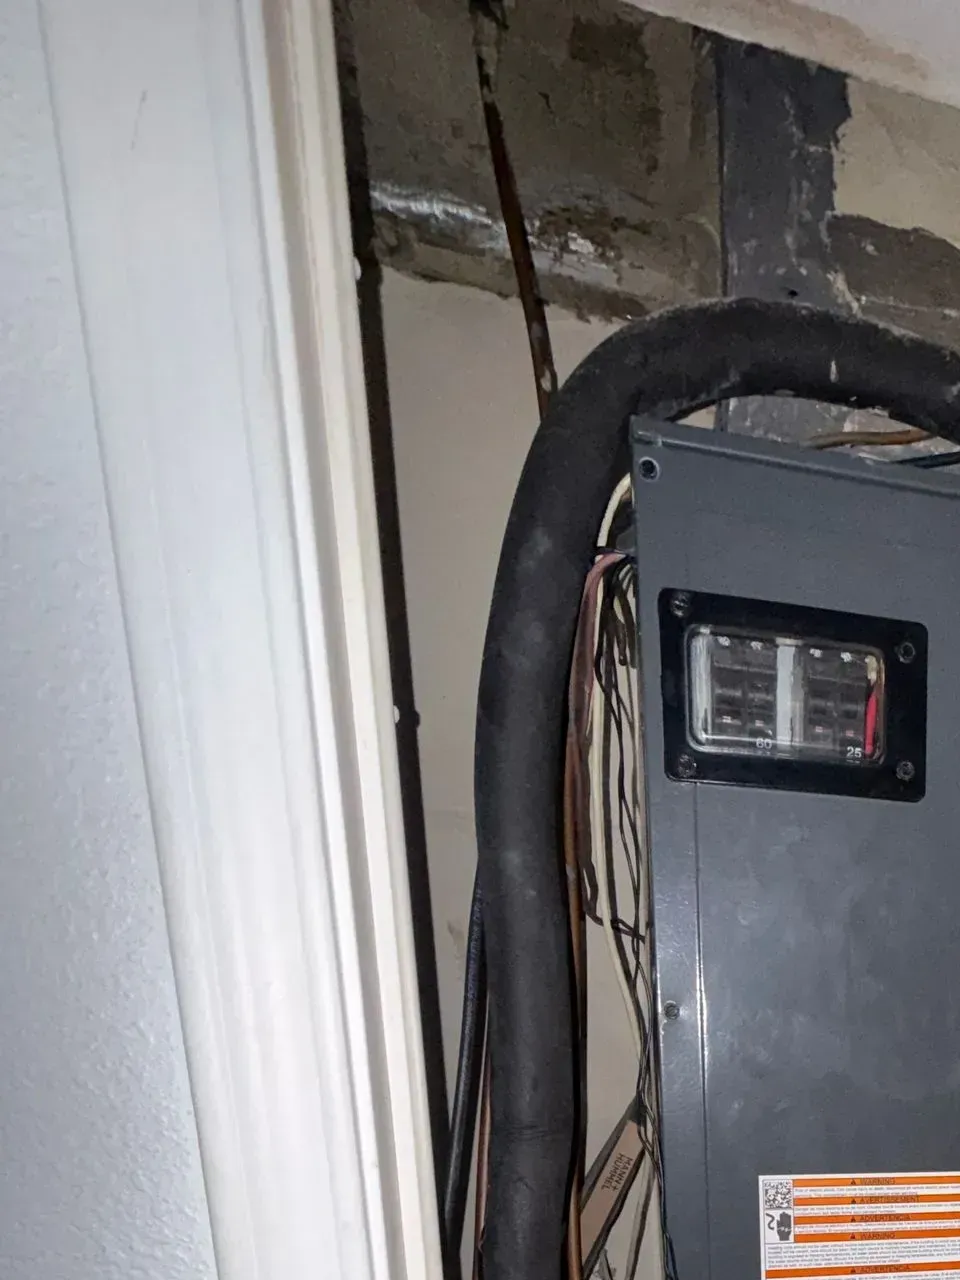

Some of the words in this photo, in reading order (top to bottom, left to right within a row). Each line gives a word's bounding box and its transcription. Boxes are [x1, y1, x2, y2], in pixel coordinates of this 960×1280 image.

[846, 746, 862, 759] 25
[601, 1152, 625, 1190] HUMMEL
[861, 1177, 896, 1186] WARNING
[861, 1195, 920, 1204] AVERTISSEMENT
[861, 1213, 911, 1222] ADVERTENCIA
[861, 1231, 896, 1240] WARNING
[861, 1263, 911, 1273] ADVERTENCIA
